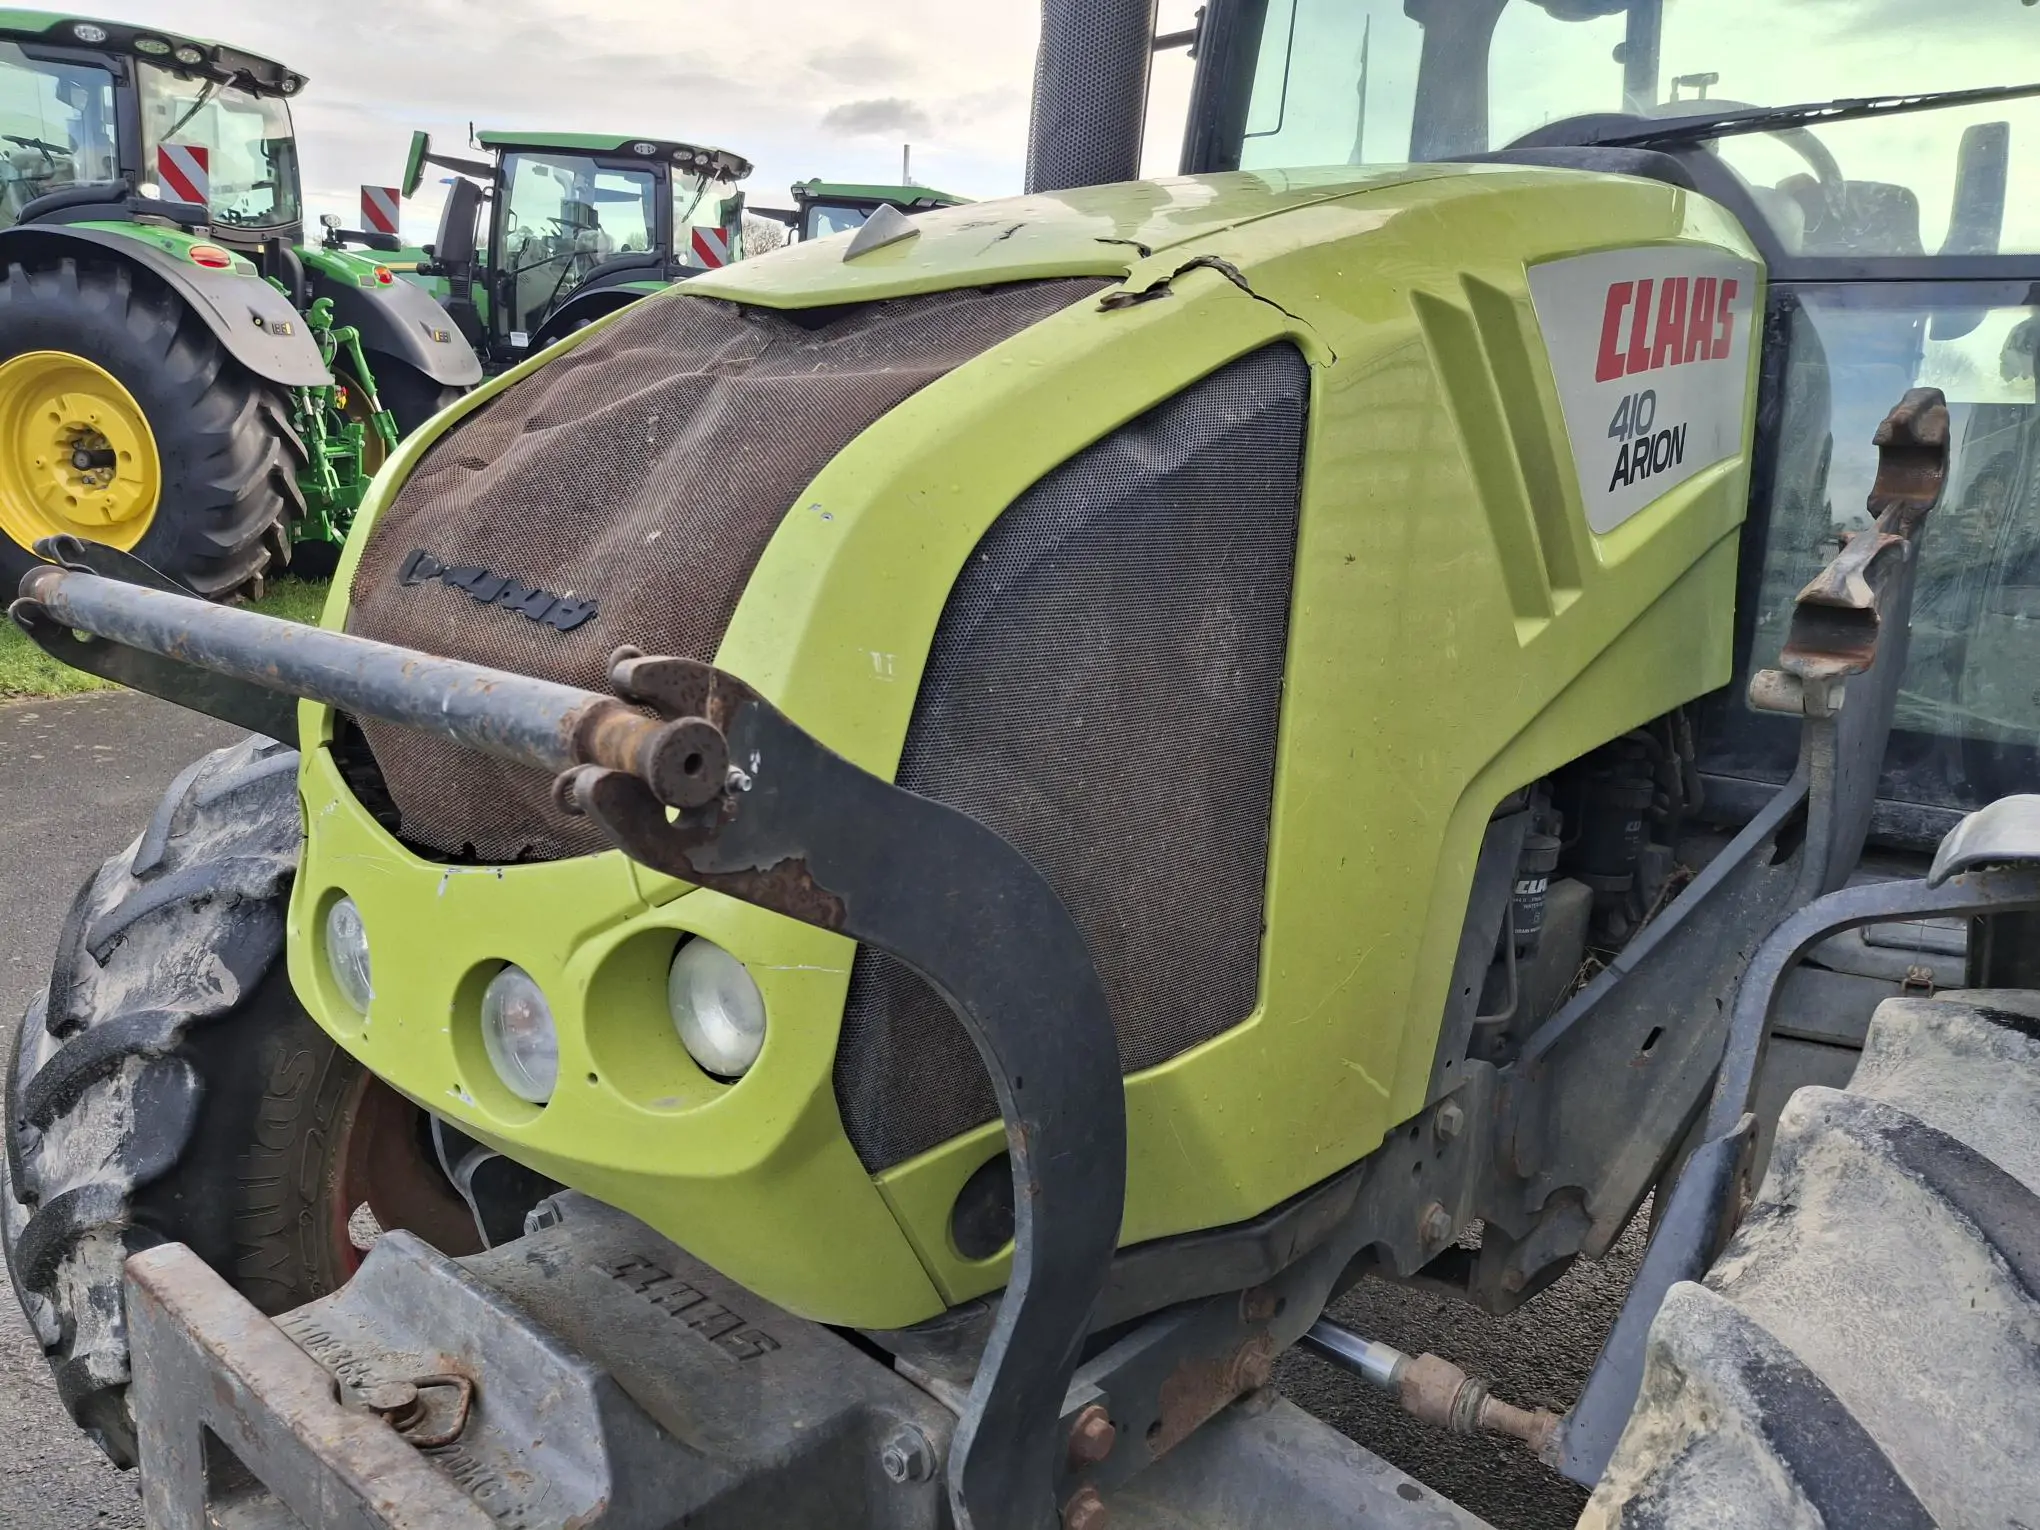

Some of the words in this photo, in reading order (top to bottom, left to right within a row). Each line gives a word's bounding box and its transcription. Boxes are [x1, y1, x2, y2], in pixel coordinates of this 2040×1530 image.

[1595, 276, 1738, 384] CLAAS
[1607, 389, 1656, 442] 410
[1608, 422, 1687, 493] ARION
